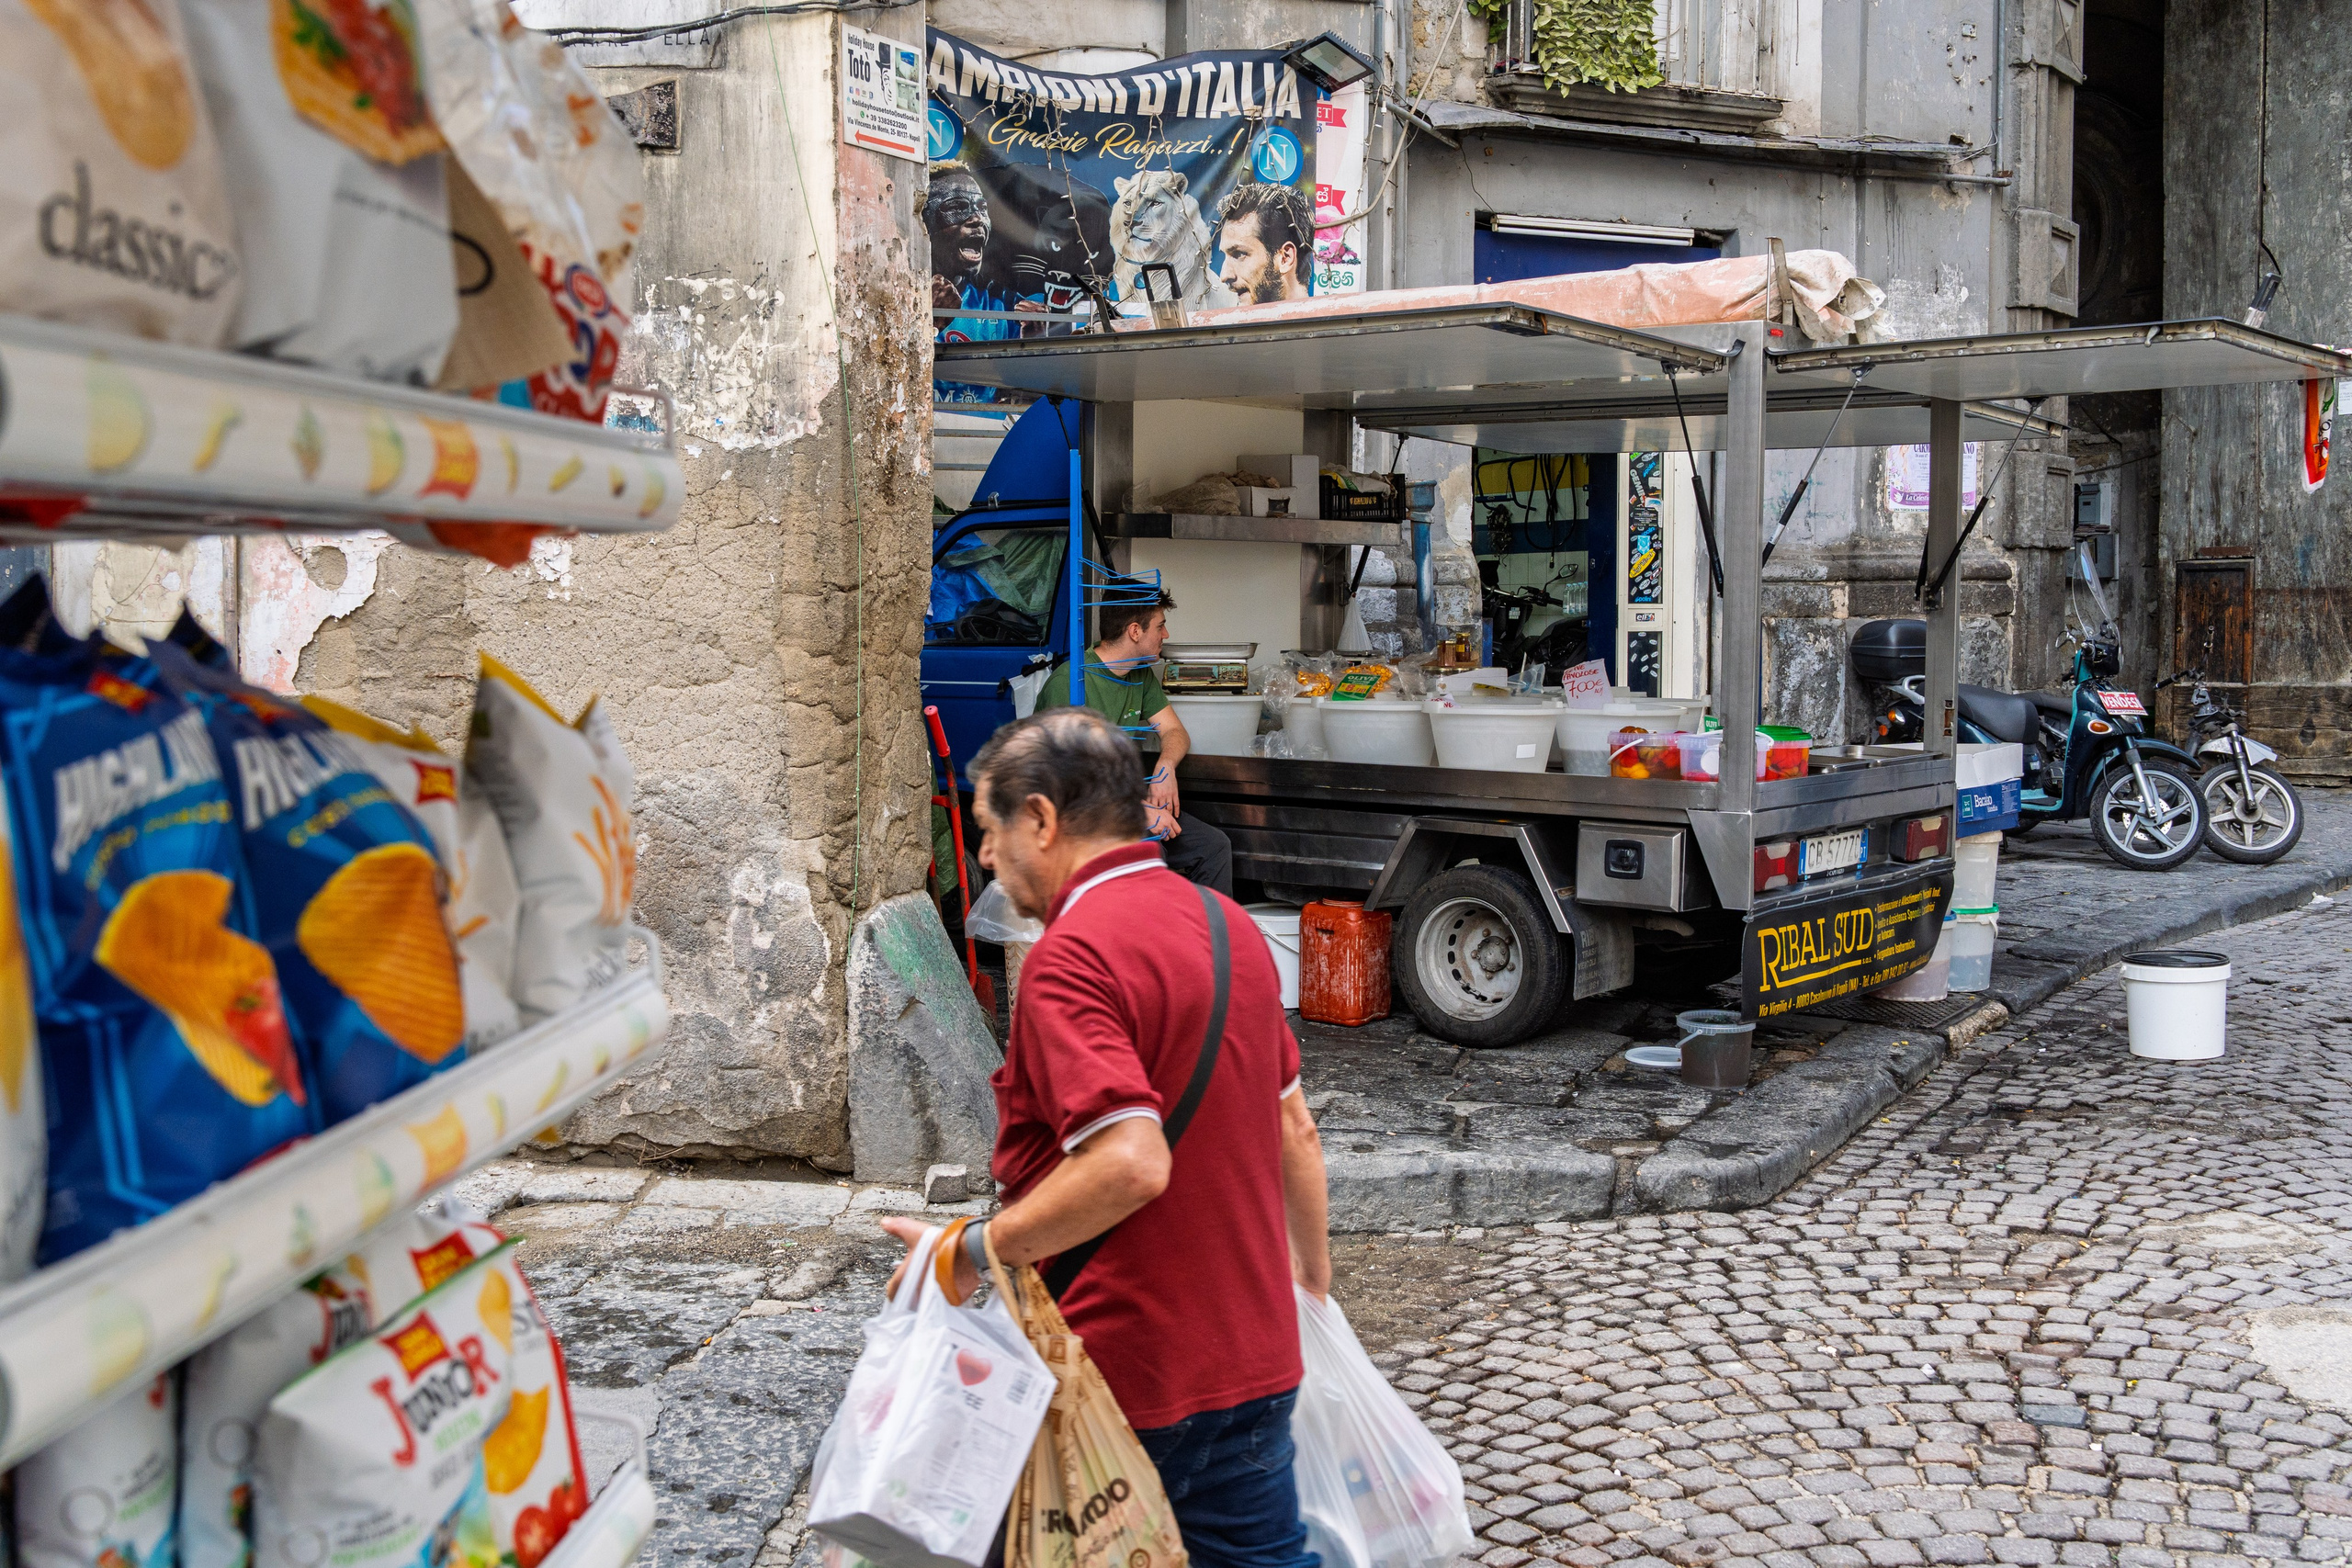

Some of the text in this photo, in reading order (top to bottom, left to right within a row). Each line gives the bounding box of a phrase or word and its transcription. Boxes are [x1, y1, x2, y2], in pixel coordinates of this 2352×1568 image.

[848, 33, 875, 51] Holiday House
[848, 49, 871, 83] Totò
[1131, 61, 1302, 119] D'ITALIA
[988, 113, 1089, 153] Grazie
[1263, 143, 1288, 171] N
[2101, 695, 2143, 709] VENDESI
[1860, 846, 1866, 859] PT
[1758, 908, 1874, 992] RIBAL SUD
[1758, 1004, 1769, 1017] Via
[1788, 998, 1792, 1010] 4
